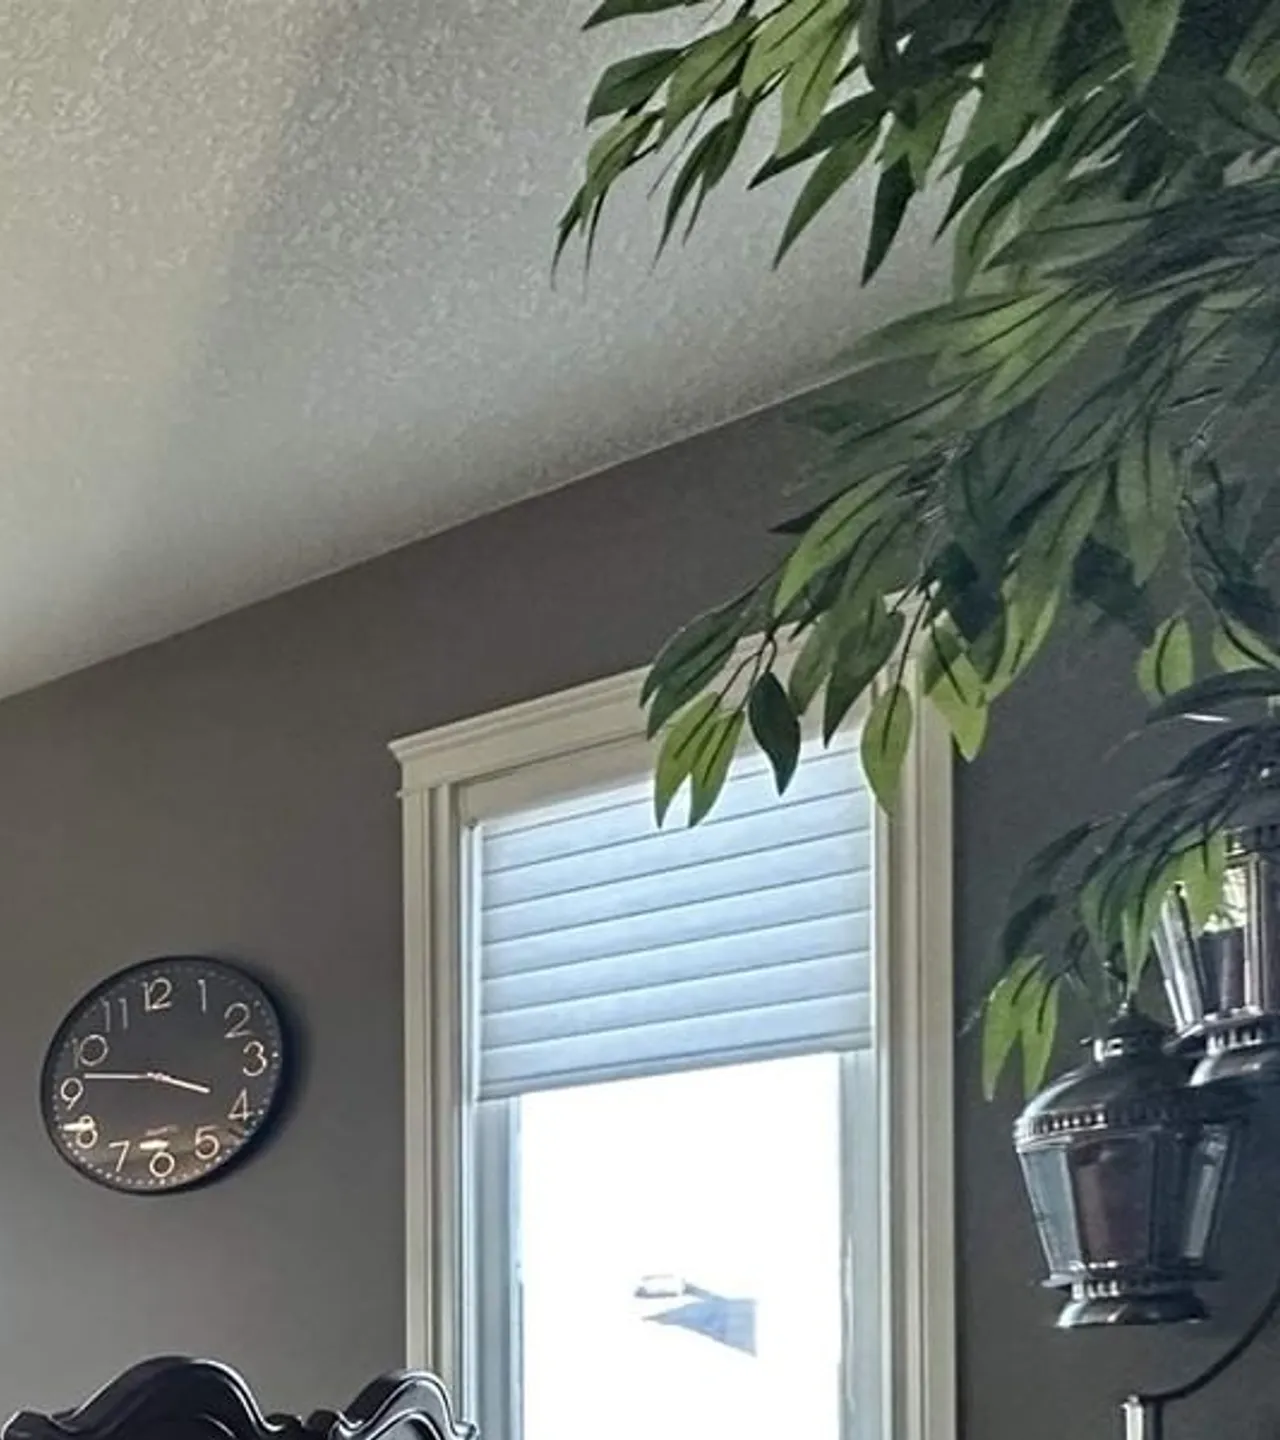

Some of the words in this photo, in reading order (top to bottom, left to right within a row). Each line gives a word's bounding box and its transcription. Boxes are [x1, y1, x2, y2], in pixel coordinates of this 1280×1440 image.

[143, 976, 173, 1012] 12
[197, 978, 208, 1013] 1
[102, 997, 129, 1033] 11
[223, 1002, 253, 1039] 2
[242, 1040, 268, 1077] 3
[59, 1077, 84, 1111] 9
[226, 1087, 253, 1121] 4
[108, 1139, 131, 1173] 7
[194, 1125, 221, 1160] 5
